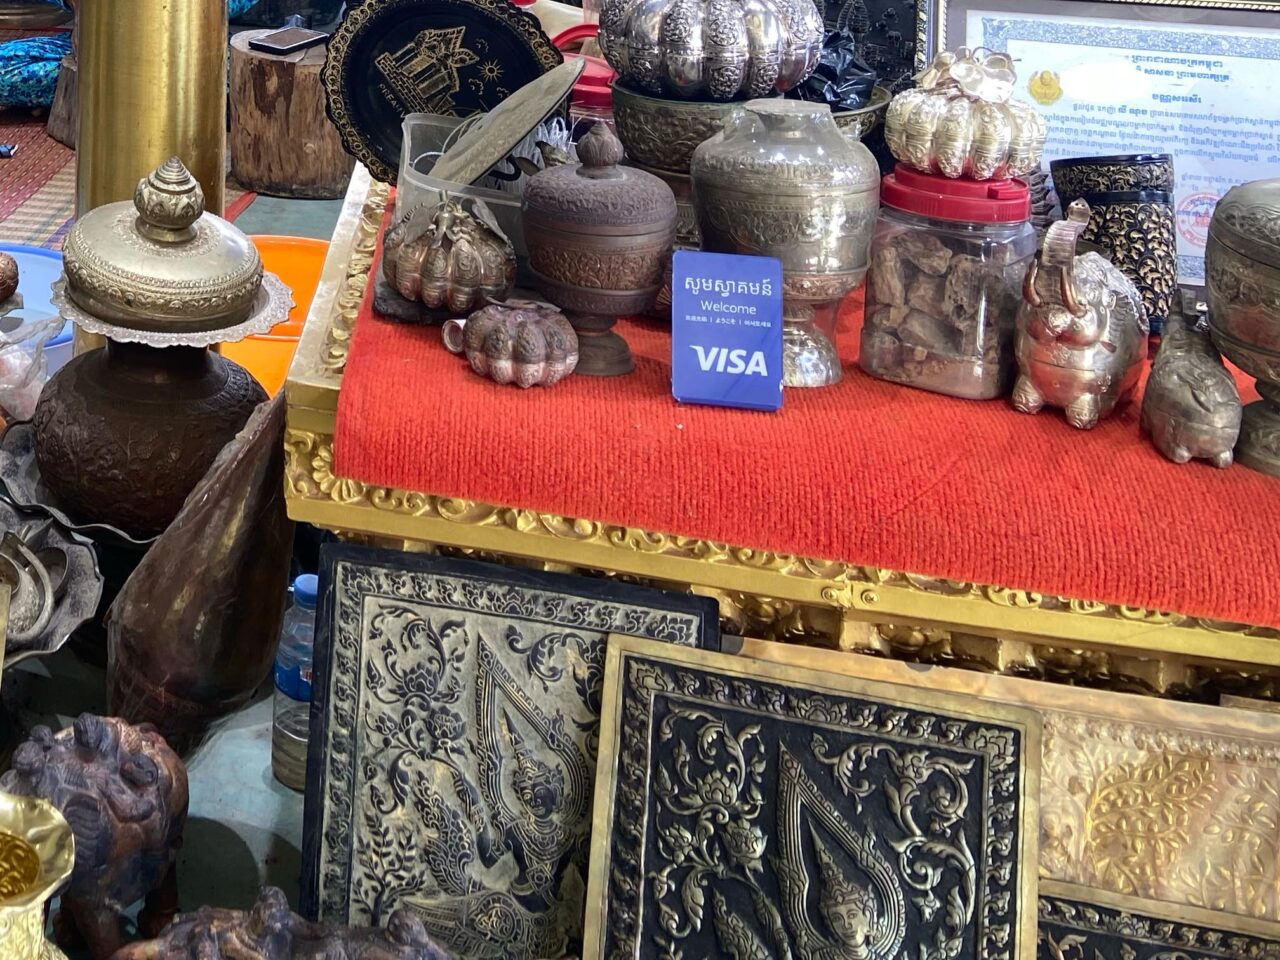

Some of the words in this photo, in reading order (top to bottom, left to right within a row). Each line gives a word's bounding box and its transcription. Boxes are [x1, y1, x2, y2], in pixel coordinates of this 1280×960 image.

[684, 277, 773, 298] សូមស្វាគមន៍
[700, 299, 757, 316] Welcome
[689, 344, 769, 377] VISA
